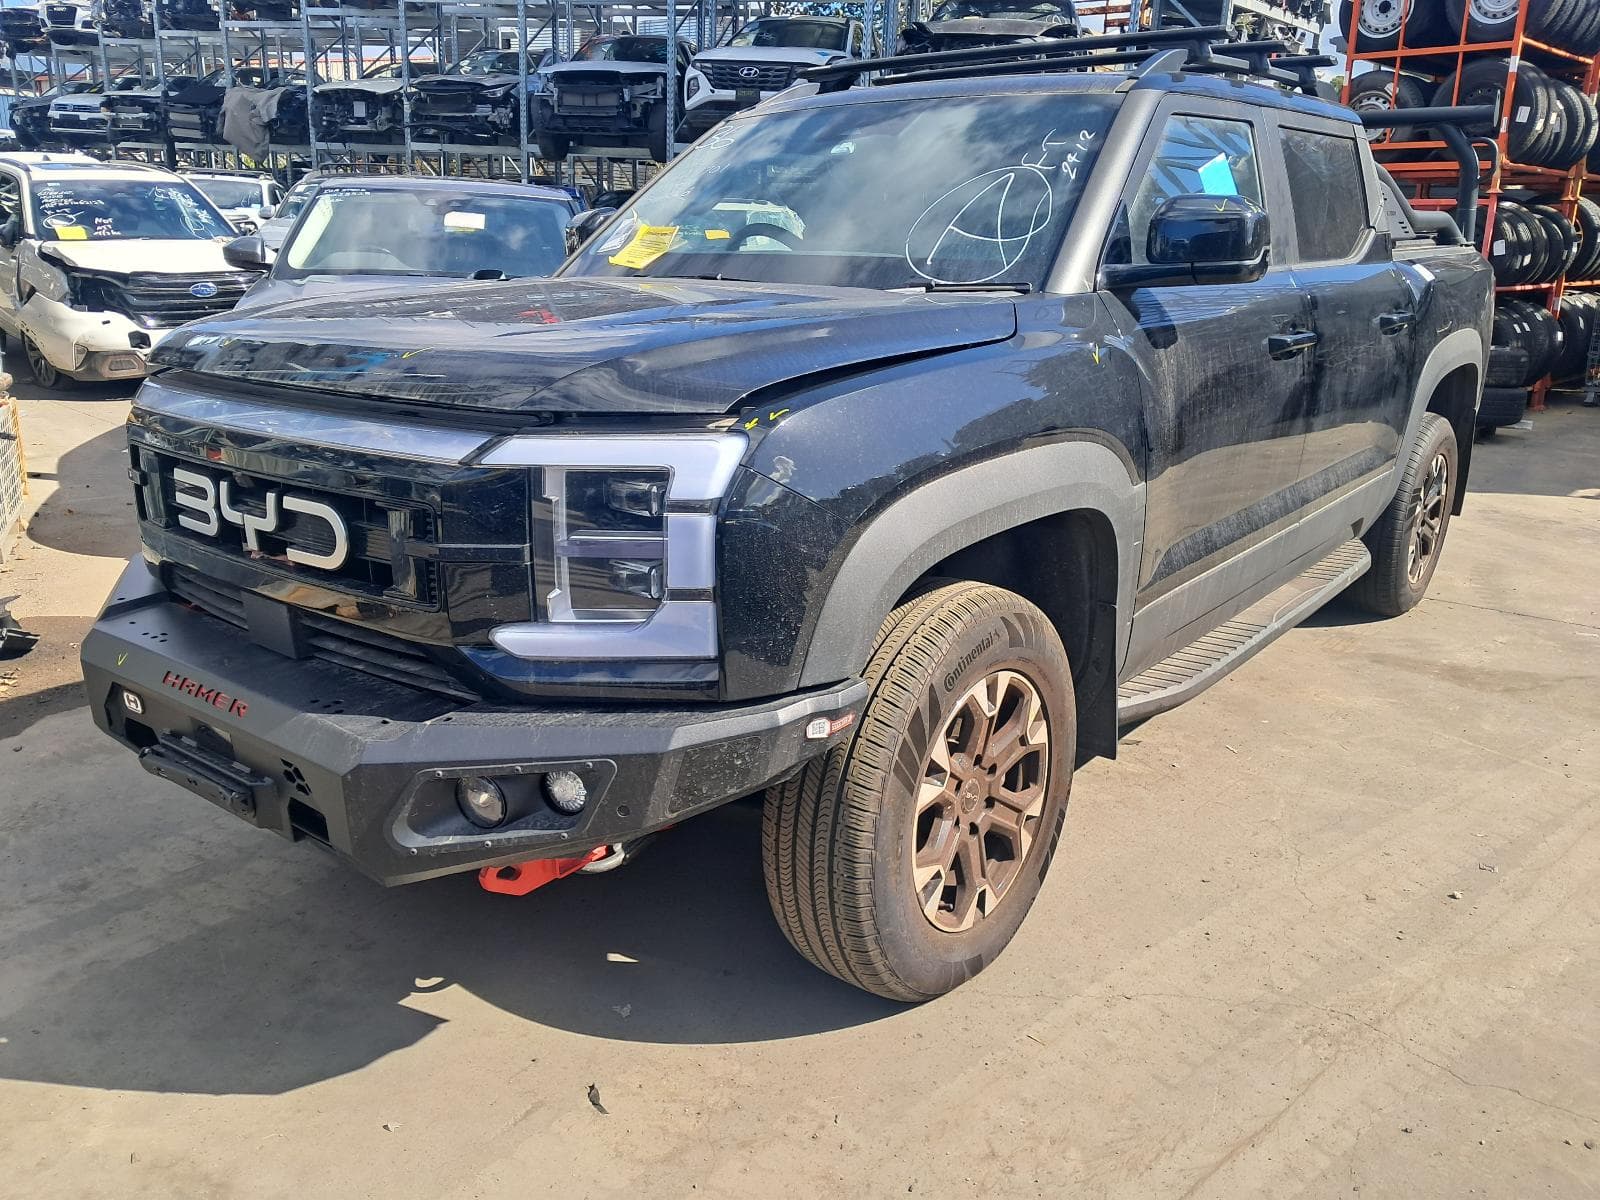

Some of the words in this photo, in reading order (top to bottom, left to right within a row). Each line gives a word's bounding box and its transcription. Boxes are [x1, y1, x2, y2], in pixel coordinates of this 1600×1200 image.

[173, 467, 348, 571] BYD
[943, 631, 994, 693] Continental
[162, 670, 249, 718] HAMER
